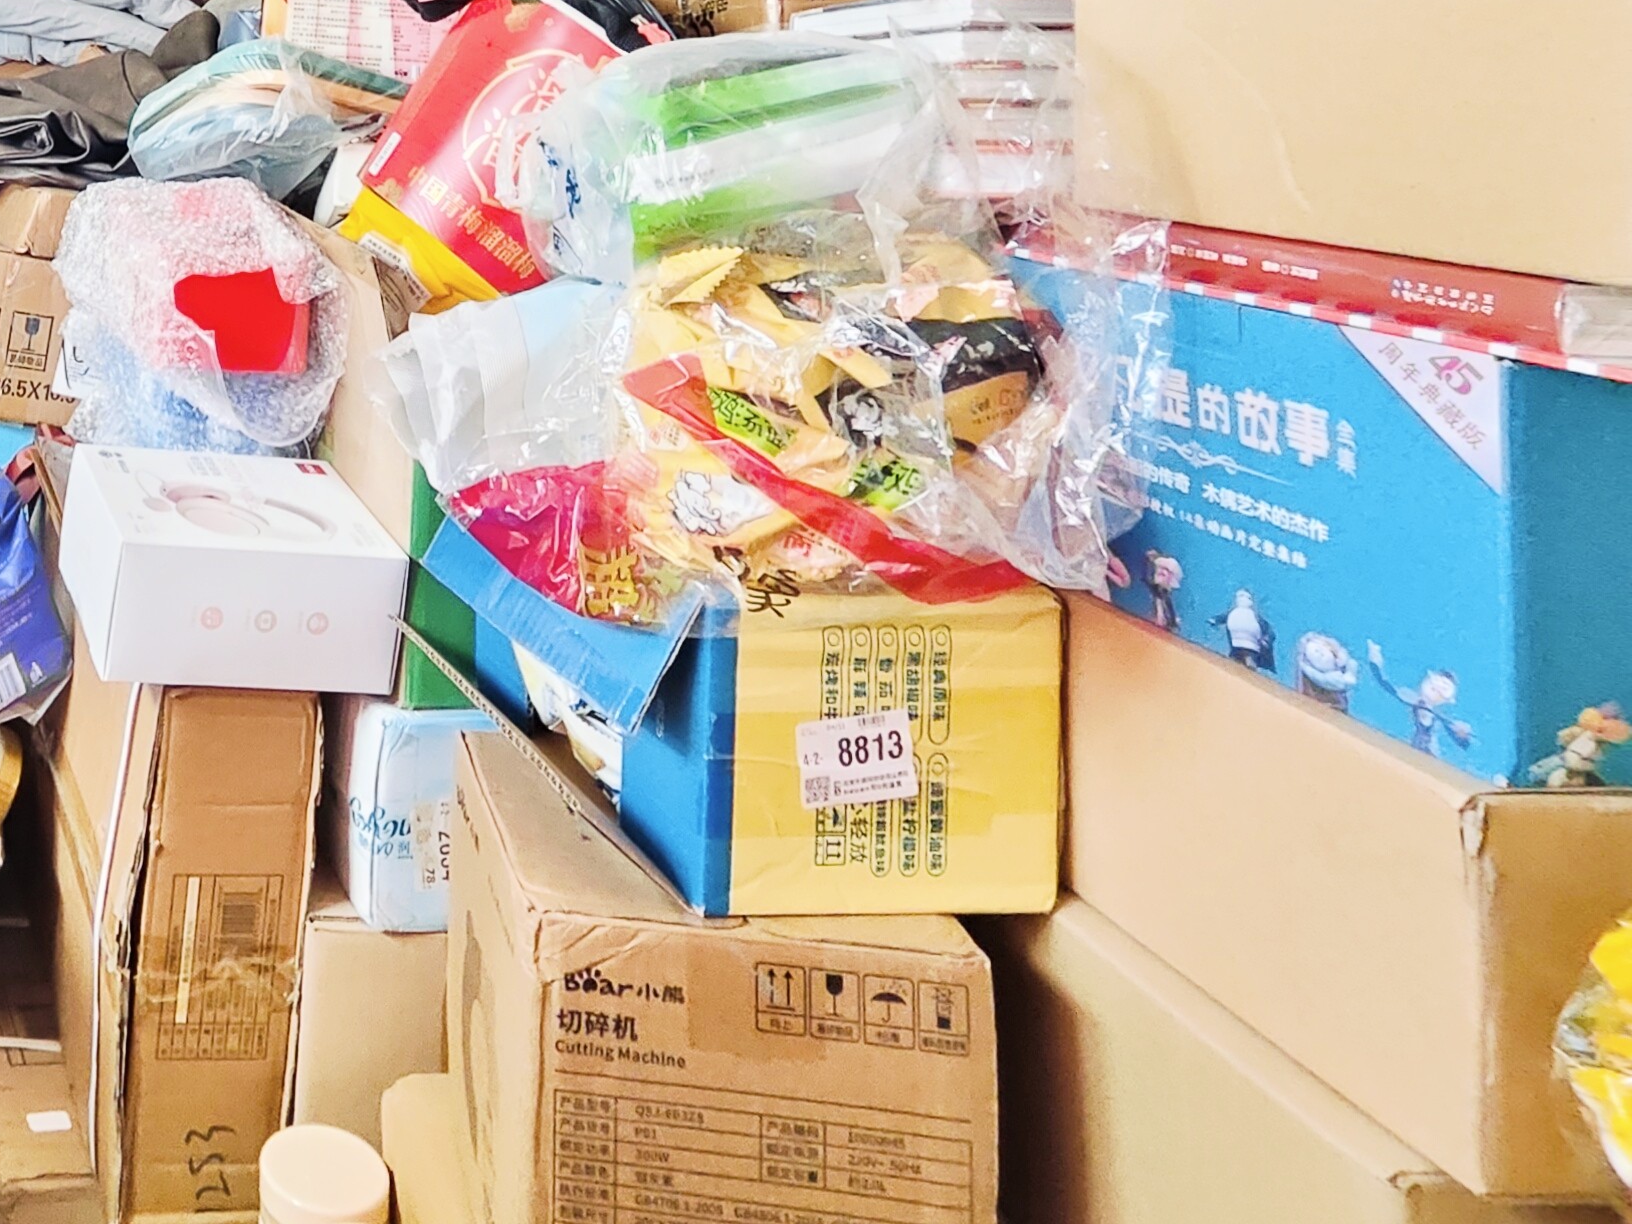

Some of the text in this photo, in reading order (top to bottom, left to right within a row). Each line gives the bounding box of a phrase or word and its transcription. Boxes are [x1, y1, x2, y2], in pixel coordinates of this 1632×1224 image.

[1378, 342, 1487, 451] 周年典藏版
[1427, 355, 1485, 396] 45
[1201, 481, 1330, 544] 木偶艺术的杰作
[906, 651, 922, 722] 黑胡椒味
[932, 651, 948, 722] 经典原味
[838, 729, 904, 768] 8813
[928, 781, 945, 872] 蜂蜜黄油味
[635, 981, 686, 1005] 小熊
[555, 1008, 639, 1041] 切碎机
[554, 1039, 687, 1070] Cutting Machine
